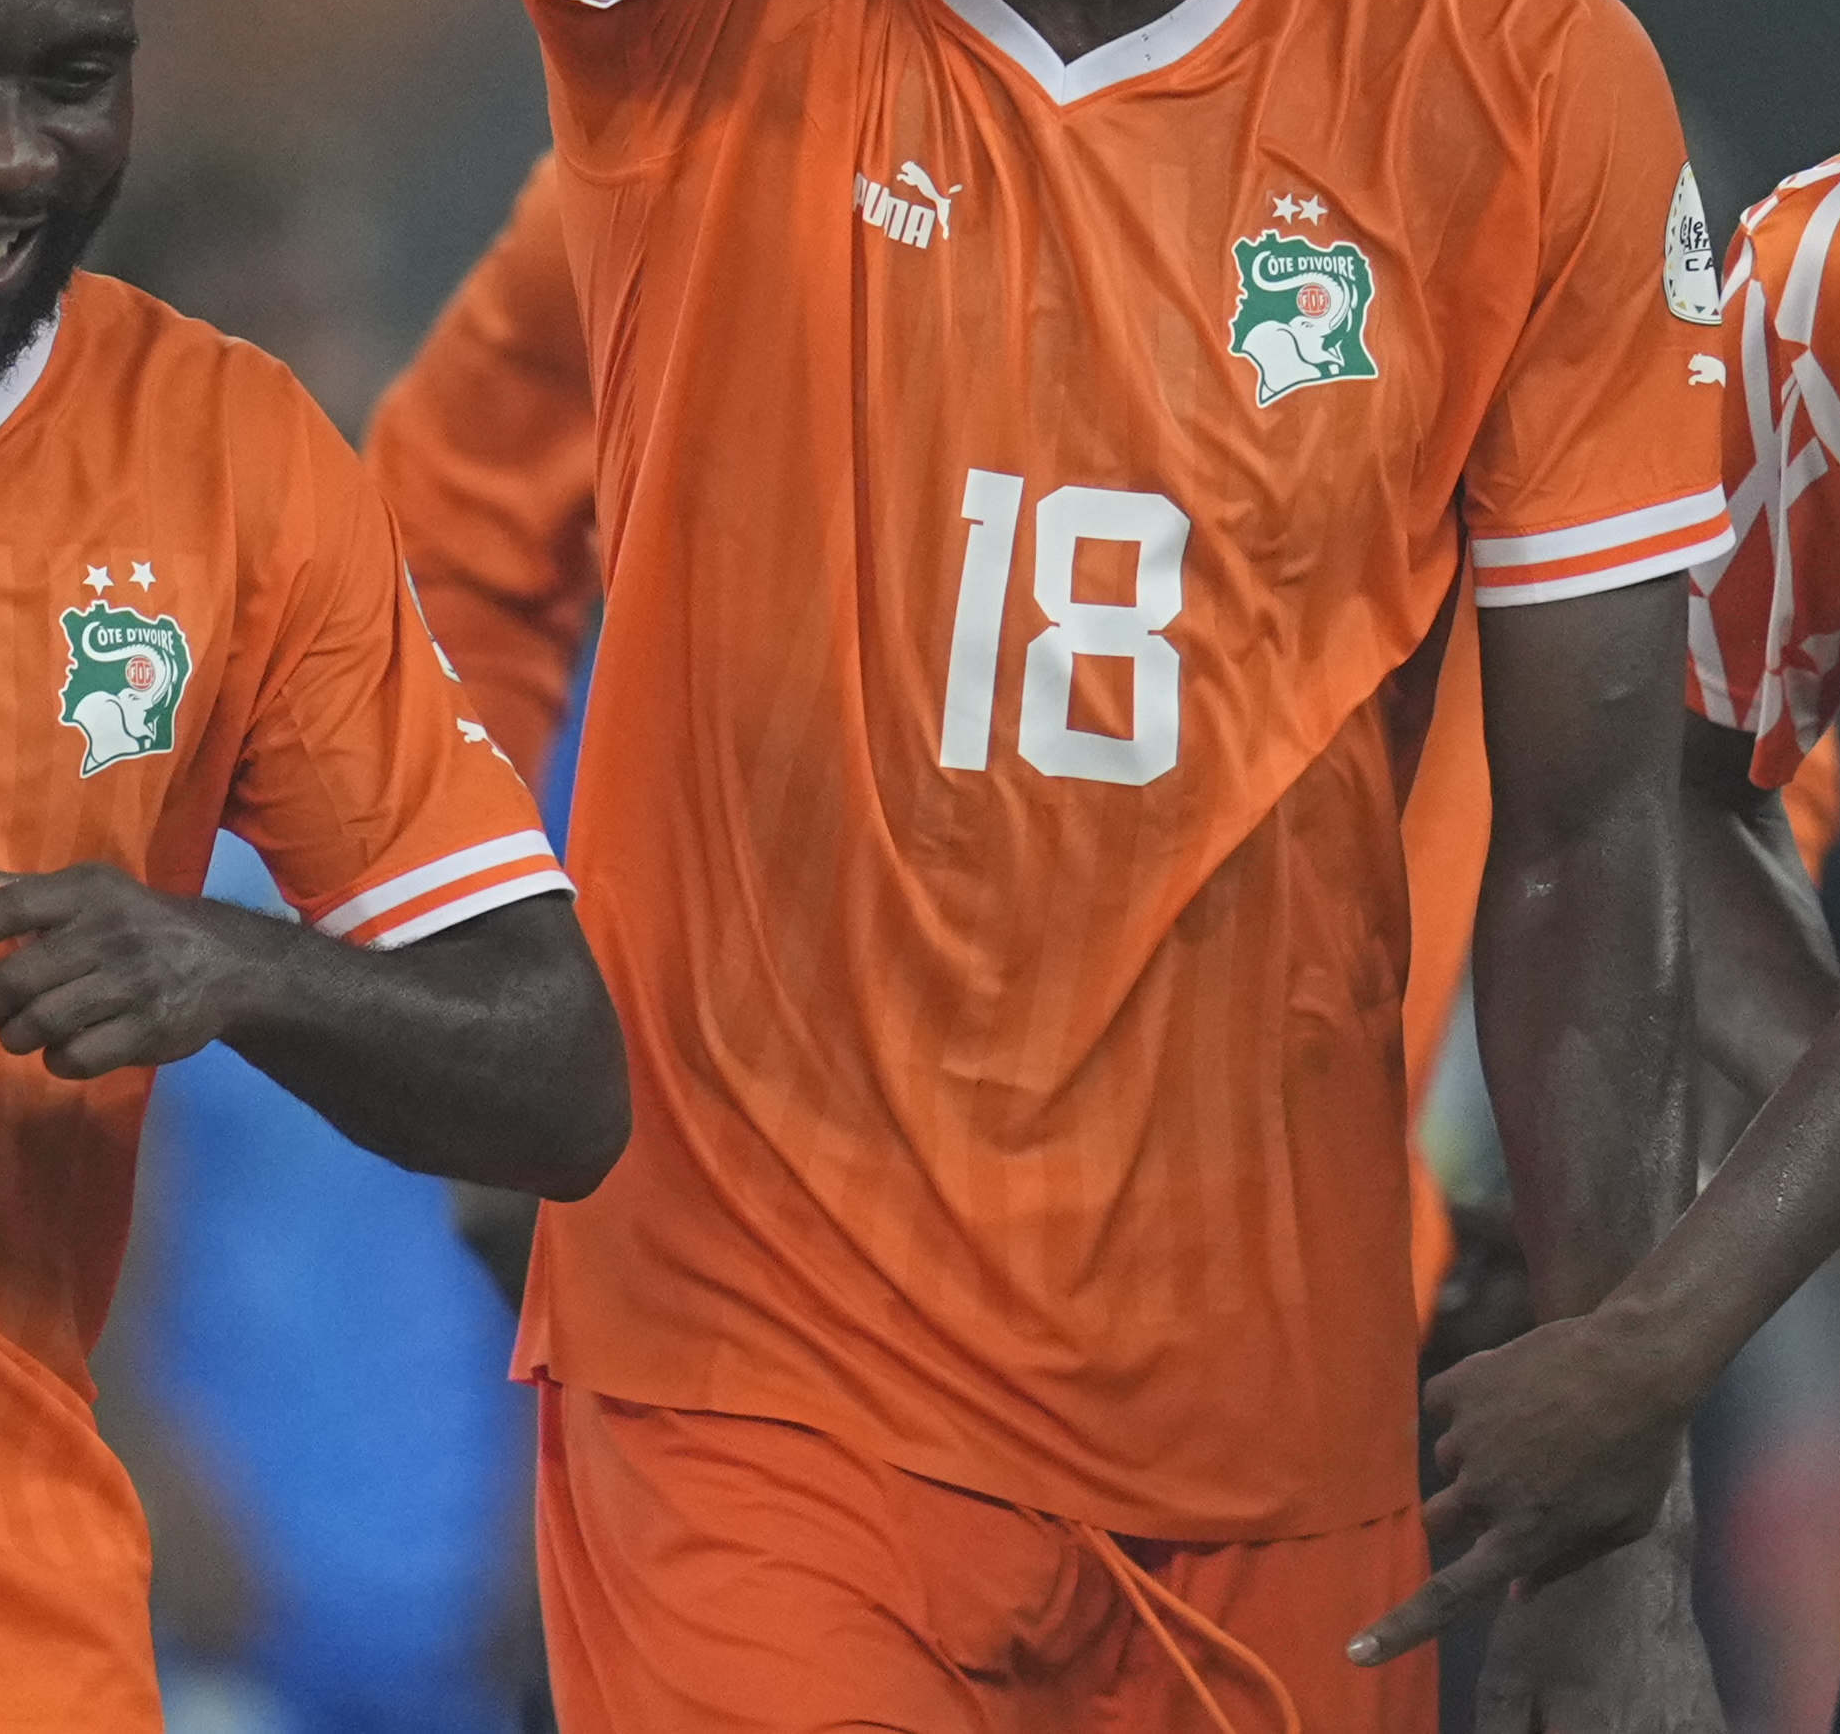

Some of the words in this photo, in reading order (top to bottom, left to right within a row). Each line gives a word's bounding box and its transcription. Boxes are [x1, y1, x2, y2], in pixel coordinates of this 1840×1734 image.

[1297, 255, 1356, 281] D'IVOIRE
[126, 627, 176, 656] D'IVOIRE
[939, 467, 1192, 787] 18
